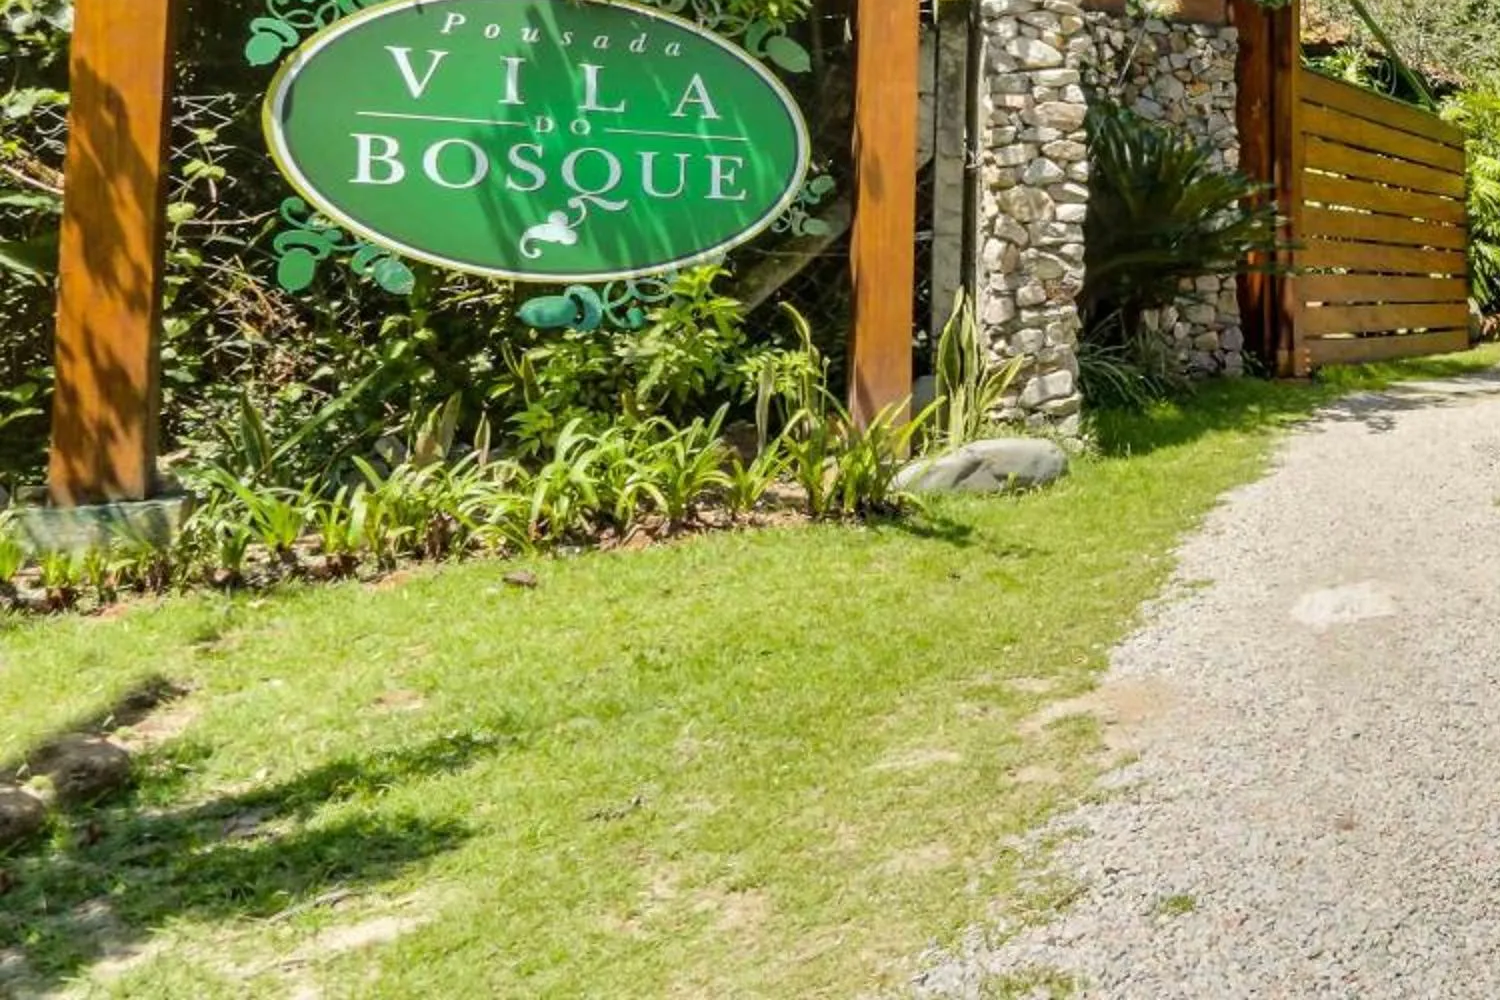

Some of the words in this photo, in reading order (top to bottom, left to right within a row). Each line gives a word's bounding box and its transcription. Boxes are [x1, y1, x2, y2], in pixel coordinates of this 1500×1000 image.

[440, 12, 682, 57] Pousada
[384, 45, 722, 119] VILA
[535, 115, 592, 136] DO
[348, 133, 747, 211] BOSQUE
